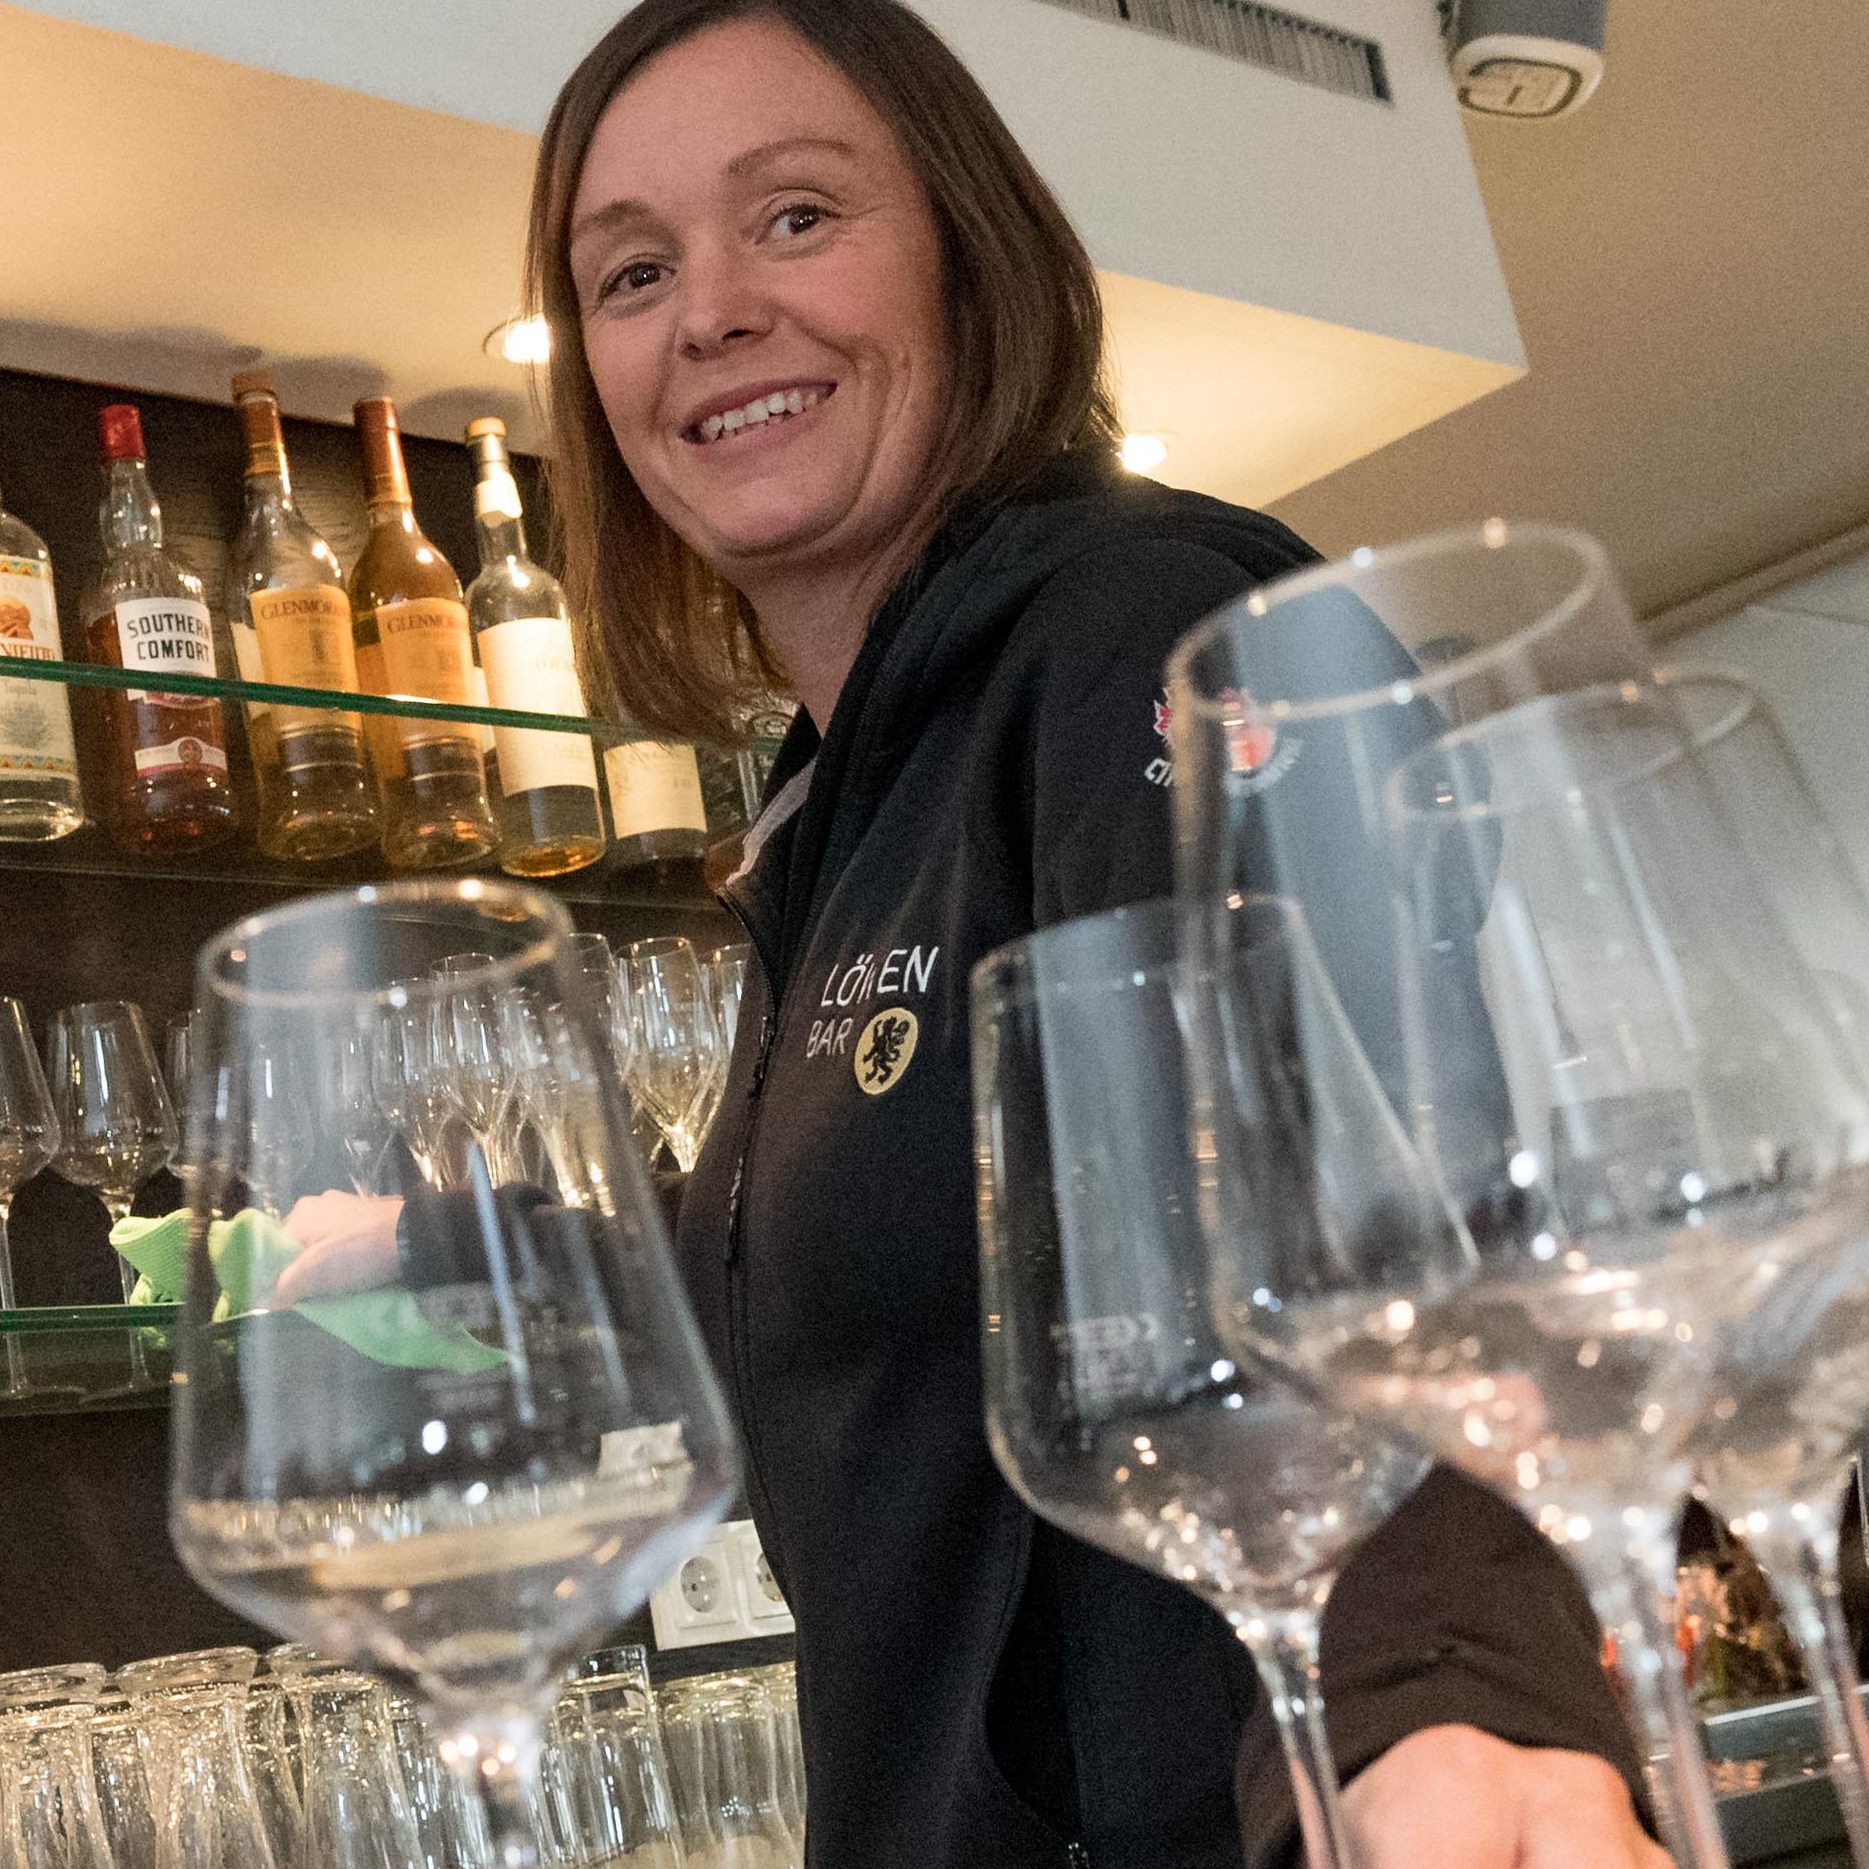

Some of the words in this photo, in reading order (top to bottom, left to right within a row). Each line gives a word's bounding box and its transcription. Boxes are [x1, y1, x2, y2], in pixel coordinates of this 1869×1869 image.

[126, 612, 210, 640] SOUTHERN
[137, 639, 210, 663] COMFORT
[806, 1017, 854, 1059] BAR
